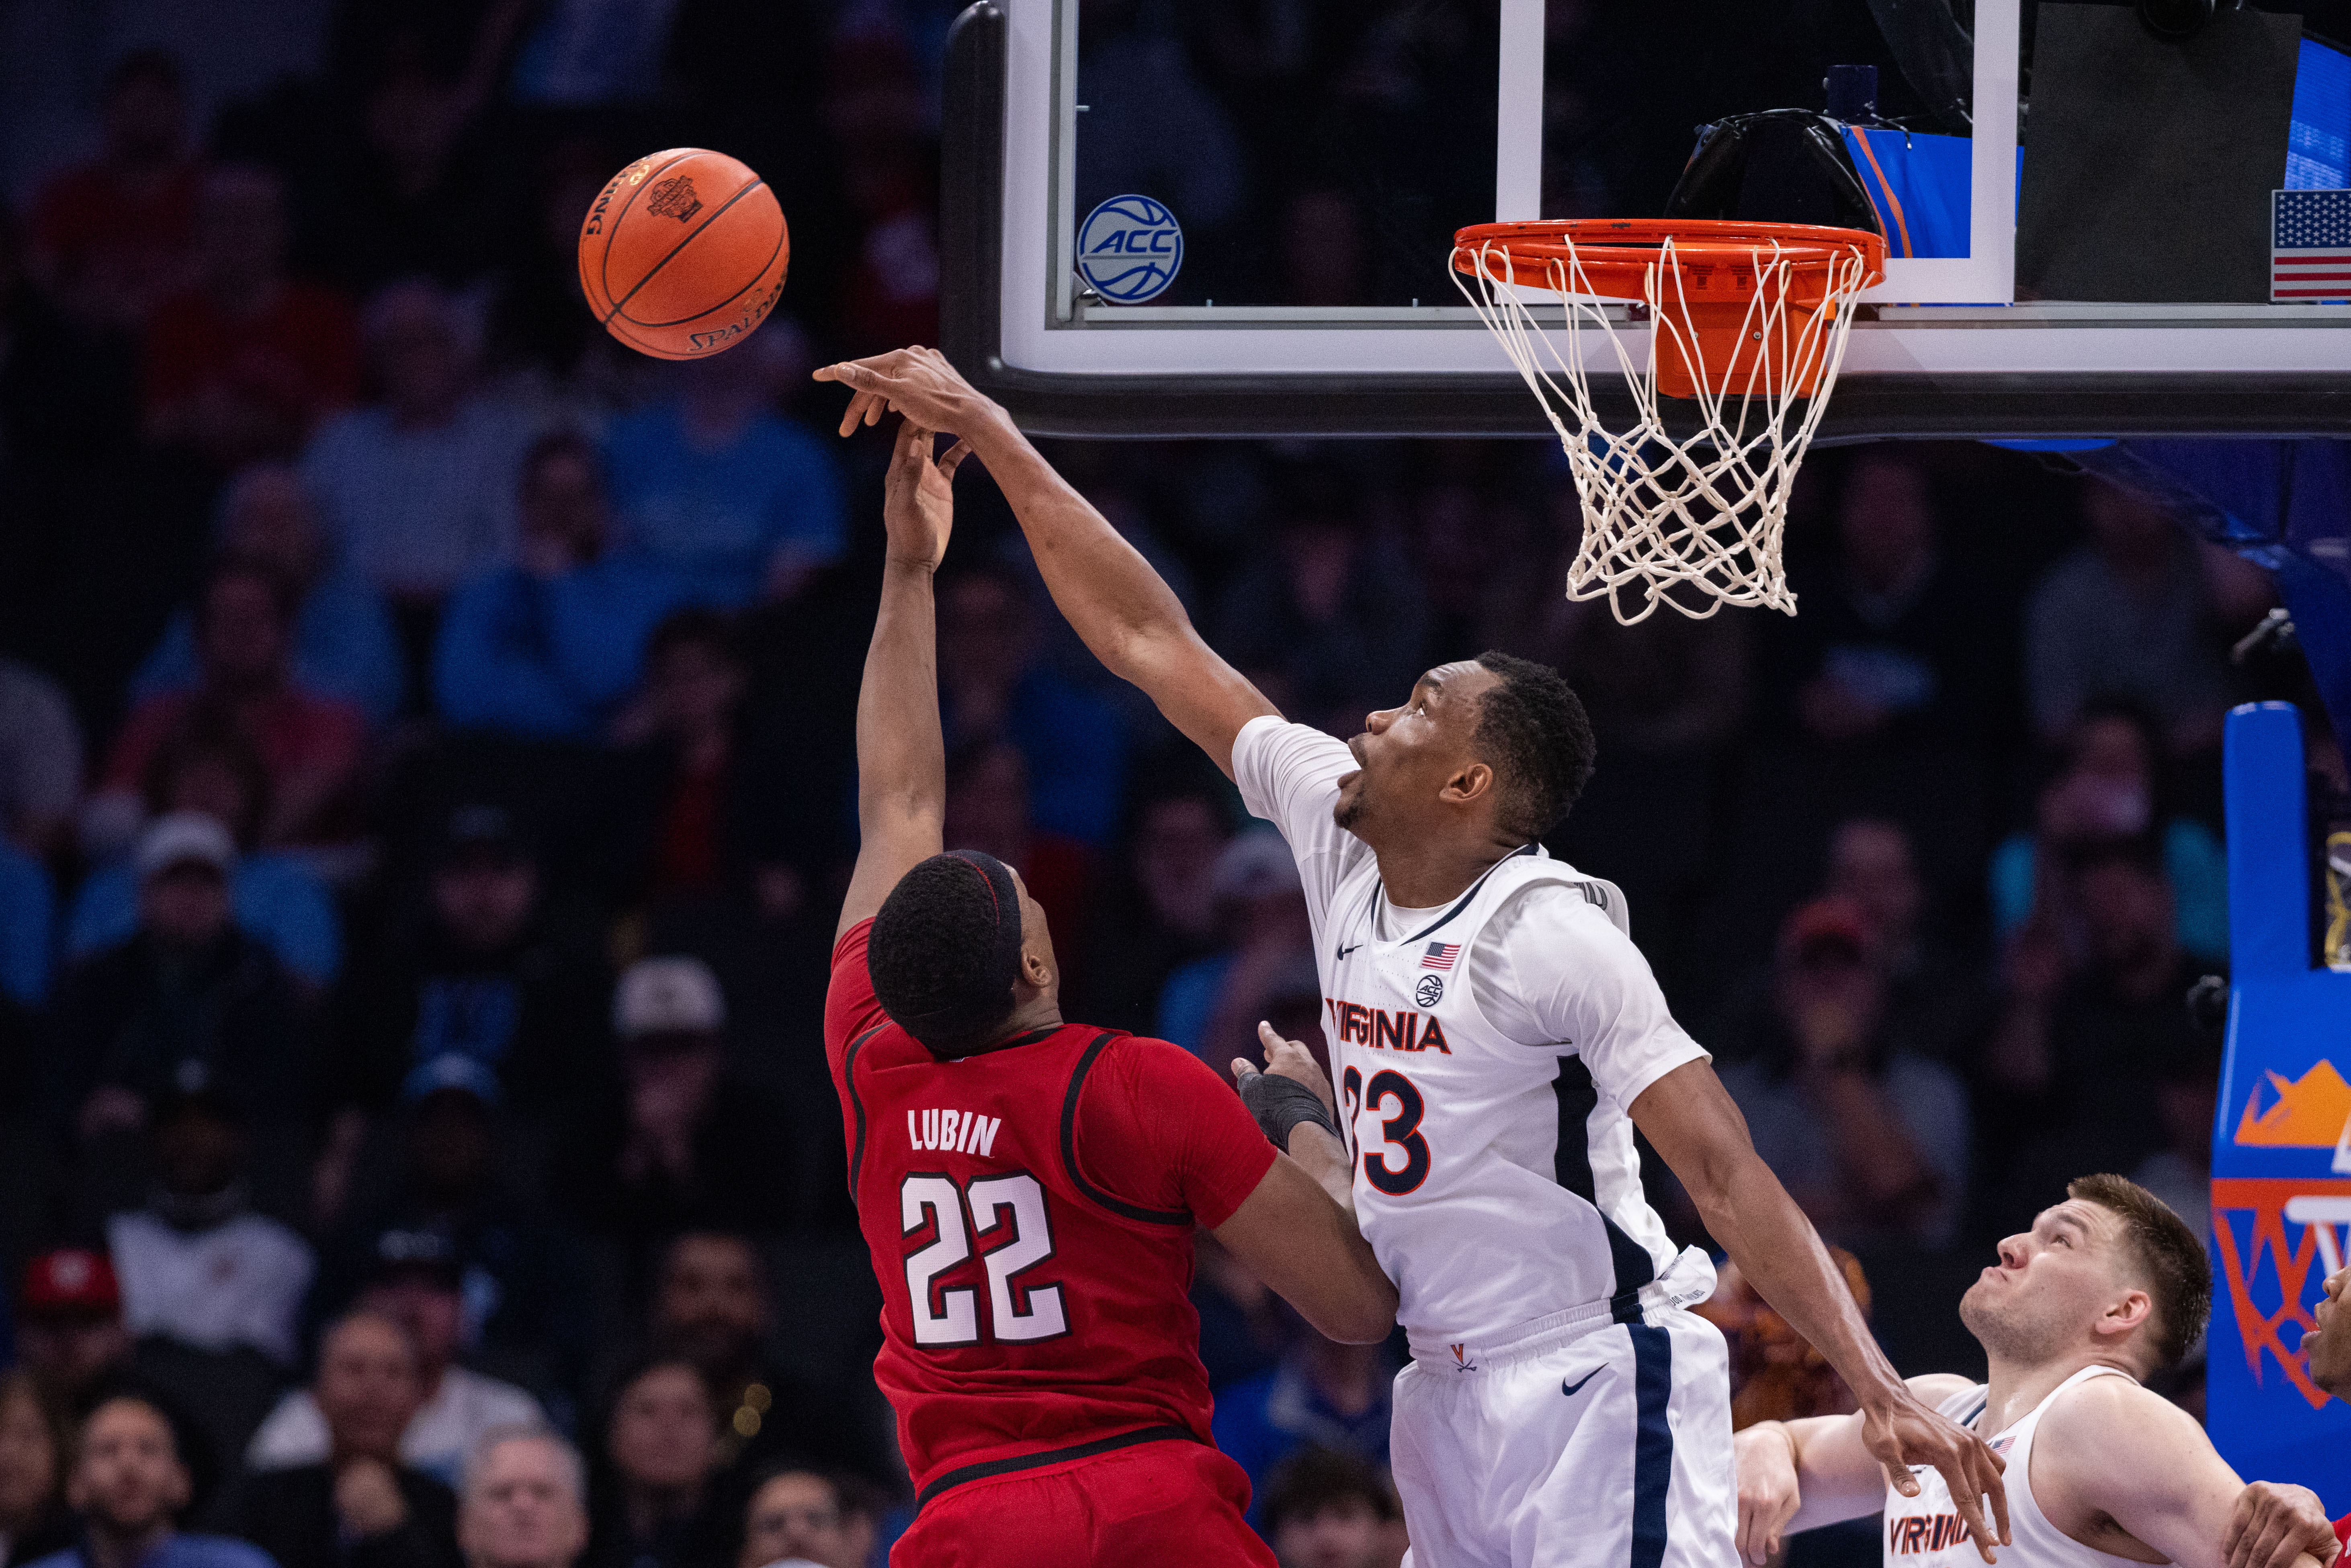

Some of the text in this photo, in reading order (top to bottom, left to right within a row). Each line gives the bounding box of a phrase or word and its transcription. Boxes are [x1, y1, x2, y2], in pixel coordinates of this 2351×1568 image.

[1090, 229, 1178, 253] ACC
[689, 271, 788, 351] SPALDI
[1419, 985, 1442, 995] ACC
[1325, 997, 1452, 1055] VIRGINIA
[907, 1108, 1001, 1157] LUBIN
[899, 1168, 1073, 1350] 22
